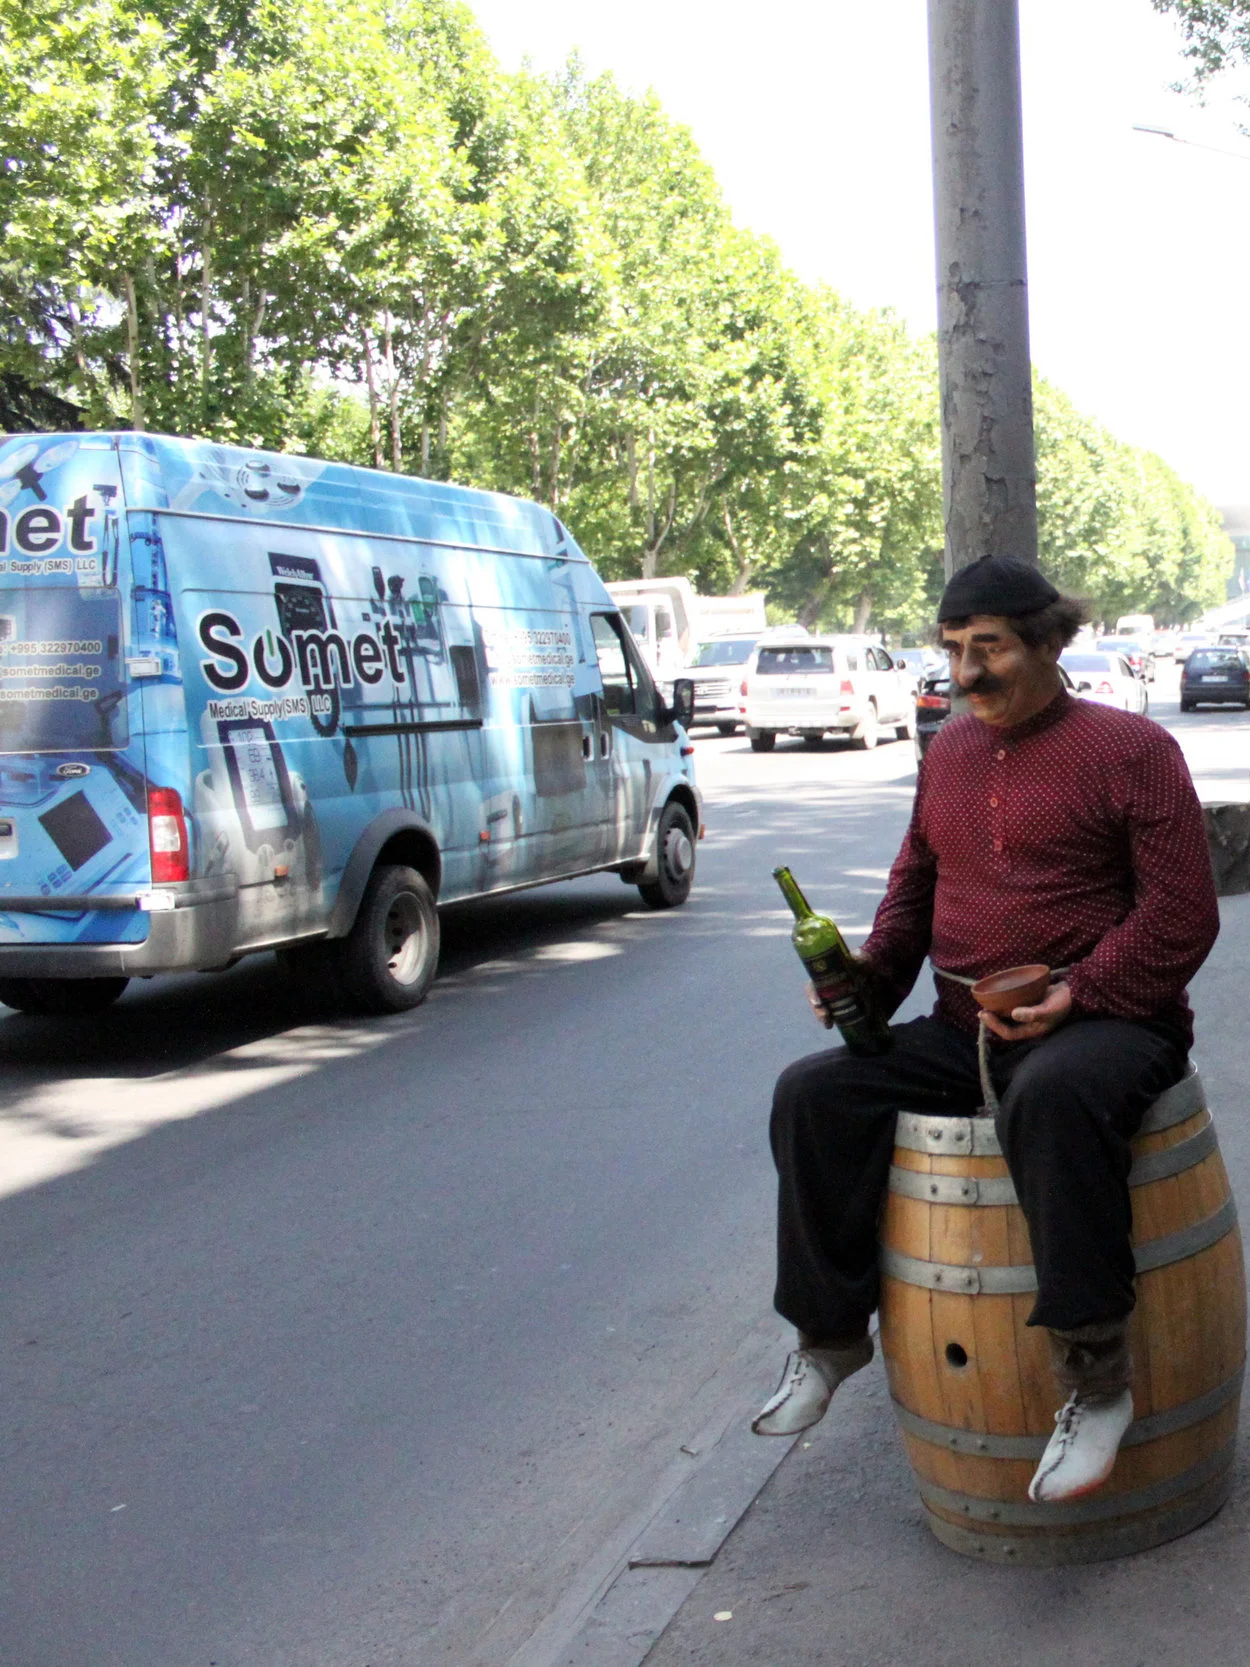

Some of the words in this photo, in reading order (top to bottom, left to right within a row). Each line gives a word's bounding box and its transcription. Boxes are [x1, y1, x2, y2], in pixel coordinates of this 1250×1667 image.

[10, 561, 41, 573] Supply
[77, 560, 96, 570] LLC
[10, 643, 37, 653] +995
[40, 642, 101, 654] 322970400
[199, 613, 404, 690] Somet
[0, 665, 100, 677] sometmedical.ge
[210, 702, 247, 718] Medical
[313, 696, 331, 712] LLC
